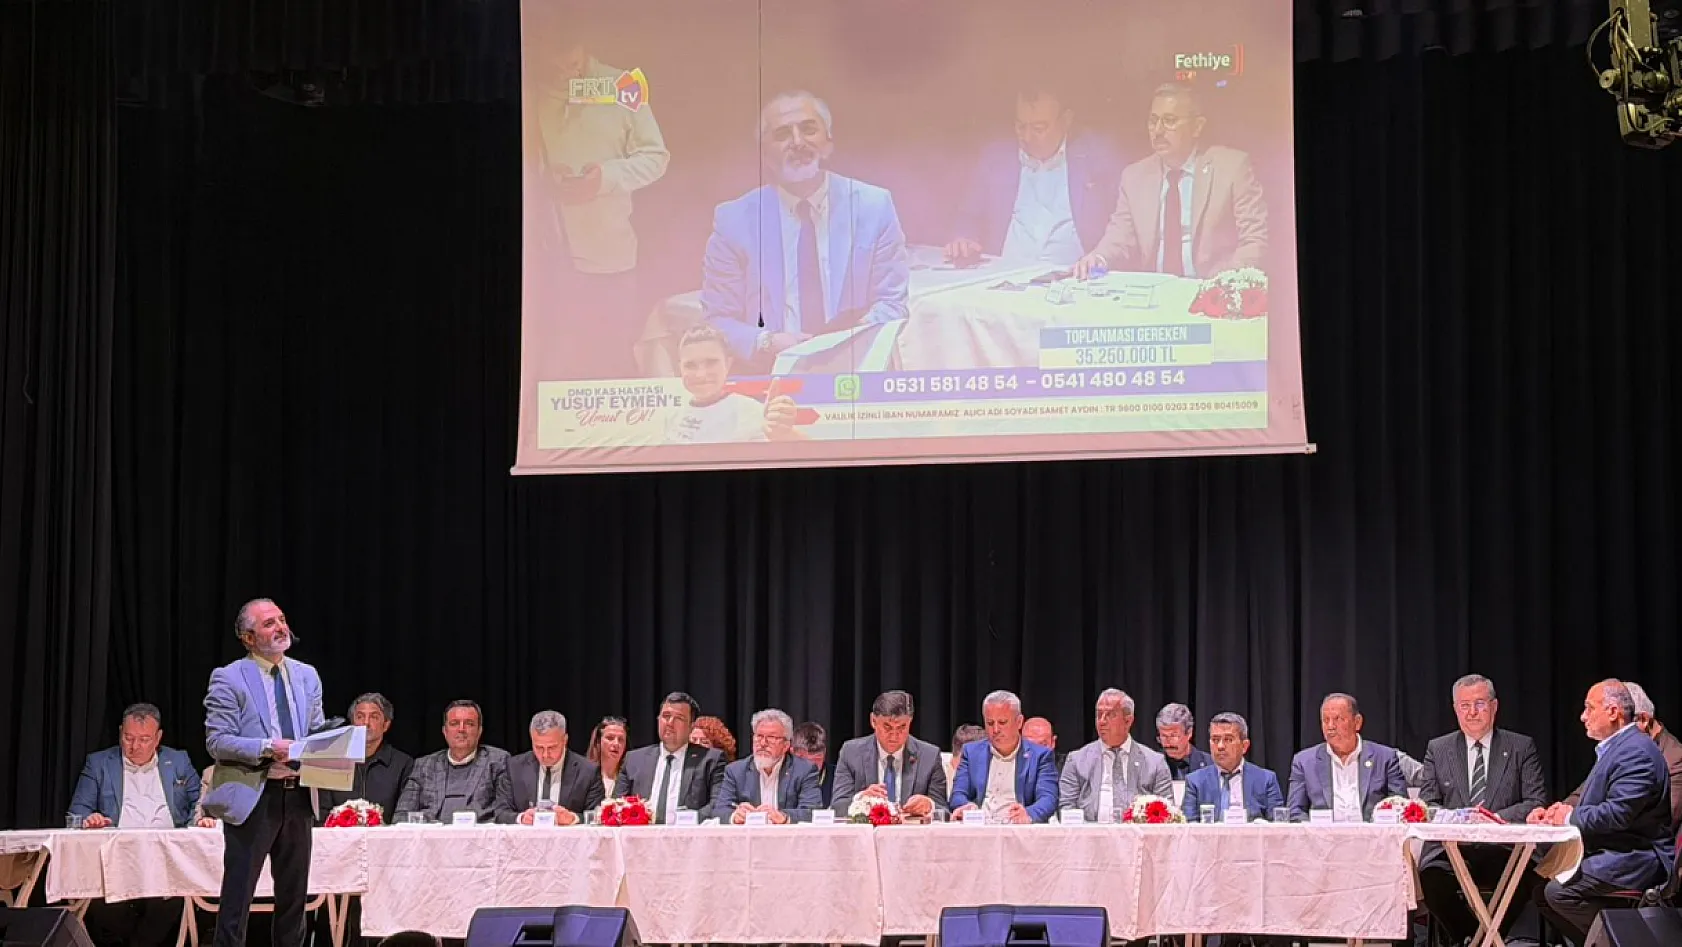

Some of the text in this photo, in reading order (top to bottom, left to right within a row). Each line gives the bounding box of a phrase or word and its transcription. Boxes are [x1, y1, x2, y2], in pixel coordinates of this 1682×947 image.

[1174, 51, 1231, 72] Fethiye
[568, 76, 639, 103] FRT tv
[1064, 325, 1188, 345] TOPLANMASI GEREKEN
[1075, 346, 1178, 366] 35.250.000 TL
[594, 387, 617, 396] KAS
[618, 385, 664, 396] HASTASI
[883, 377, 925, 393] 0531
[930, 376, 961, 392] 581
[964, 375, 990, 391] 48
[993, 374, 1019, 390] 54
[1040, 372, 1085, 389] 0541
[1089, 371, 1127, 387] 480
[1130, 370, 1157, 386] 48
[1160, 369, 1186, 385] 54
[550, 394, 682, 411] YUSUF EYMEN'E
[1004, 406, 1038, 416] SOYADI
[1039, 405, 1070, 415] SAMET
[1104, 405, 1116, 413] TR
[1142, 403, 1164, 412] 0100
